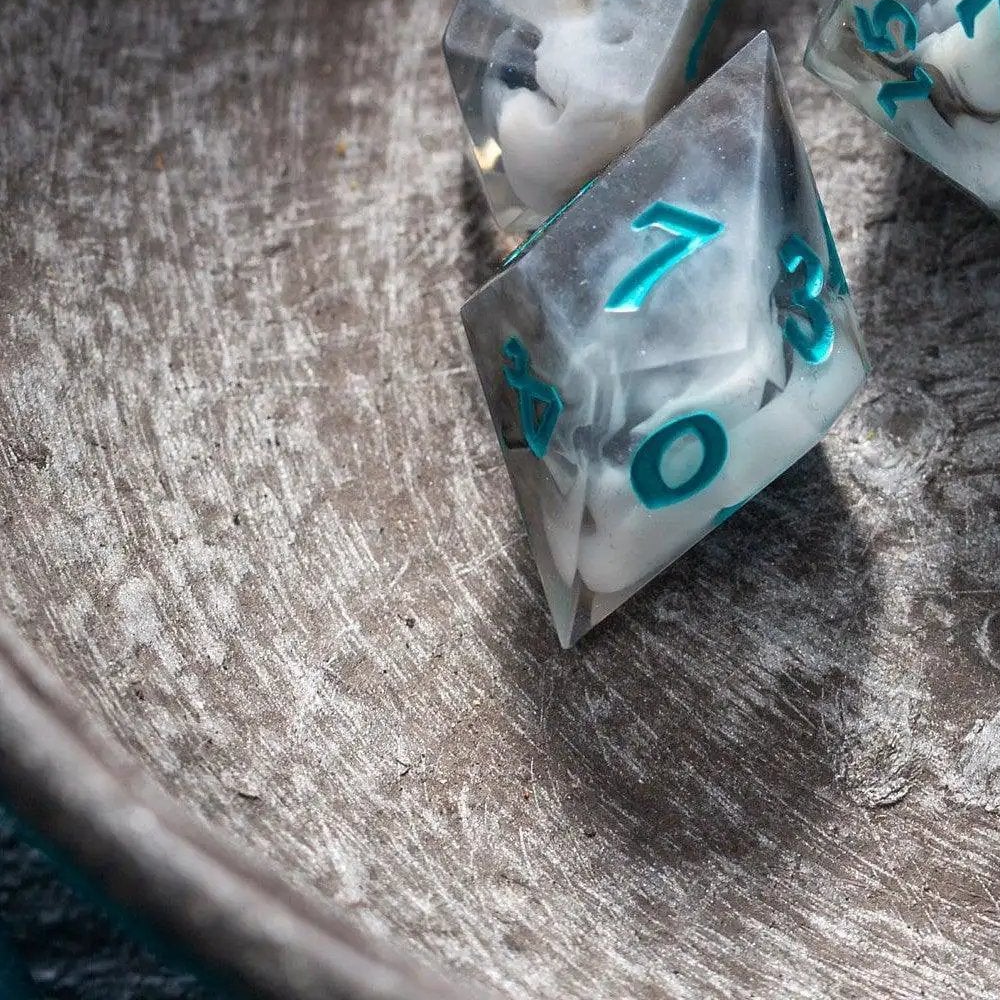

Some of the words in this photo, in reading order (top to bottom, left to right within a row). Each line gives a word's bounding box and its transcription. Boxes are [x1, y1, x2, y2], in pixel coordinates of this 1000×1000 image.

[604, 200, 725, 312] 7
[779, 233, 835, 366] 3
[502, 335, 566, 460] 4
[629, 410, 728, 510] 0
